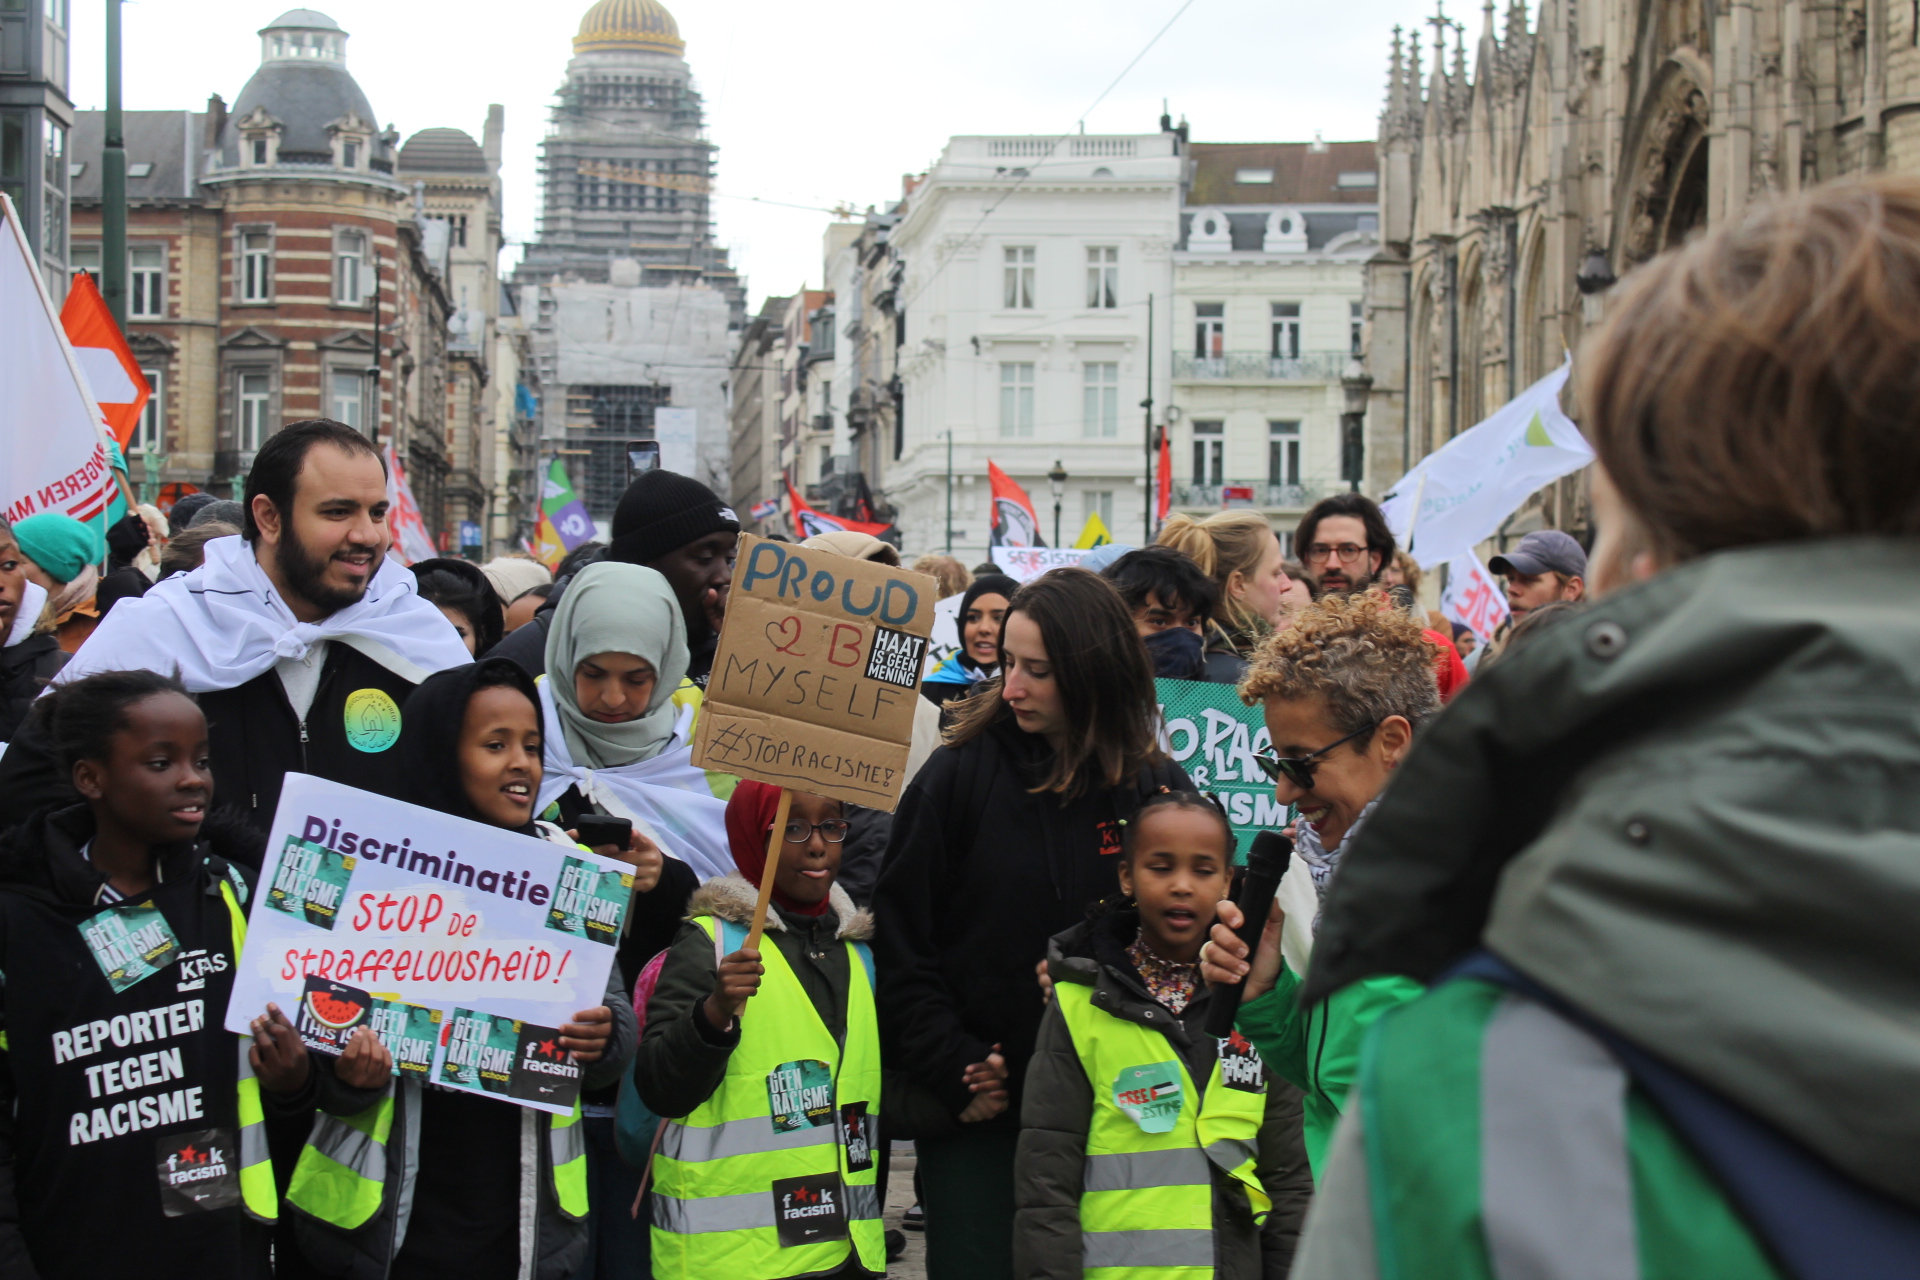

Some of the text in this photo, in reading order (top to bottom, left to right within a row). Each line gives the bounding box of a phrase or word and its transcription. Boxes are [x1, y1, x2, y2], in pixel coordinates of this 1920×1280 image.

[742, 542, 919, 625] PROUD
[827, 623, 863, 668] B
[874, 629, 924, 659] HAAT
[867, 663, 915, 687] MENING
[871, 649, 918, 673] IS GEEN
[722, 653, 902, 720] MYSELF
[1200, 708, 1278, 785] PLAC
[282, 844, 323, 877] GEEN
[302, 815, 550, 906] Discriminatie
[274, 866, 343, 910] RACISME
[561, 865, 601, 896] GEEN
[305, 902, 334, 917] school
[554, 886, 622, 927] RACISME
[86, 913, 129, 951] GEEN
[586, 920, 616, 934] school
[97, 919, 170, 973] RACISME
[144, 941, 174, 961] school
[52, 999, 205, 1066] REPORTER
[370, 1007, 408, 1037] GEEN
[452, 1016, 491, 1046] GEEN
[375, 1032, 433, 1065] ACISME
[447, 1038, 516, 1075] RACISME
[85, 1047, 185, 1098] TEGEN
[399, 1062, 429, 1073] school
[480, 1070, 510, 1082] school
[522, 1058, 580, 1079] racism
[769, 1068, 803, 1094] GEEN
[771, 1084, 831, 1116] RACISME
[807, 1106, 831, 1117] school
[1117, 1088, 1150, 1107] FREE
[69, 1086, 204, 1146] RACISME
[169, 1162, 228, 1186] racism
[783, 1201, 836, 1221] racism
